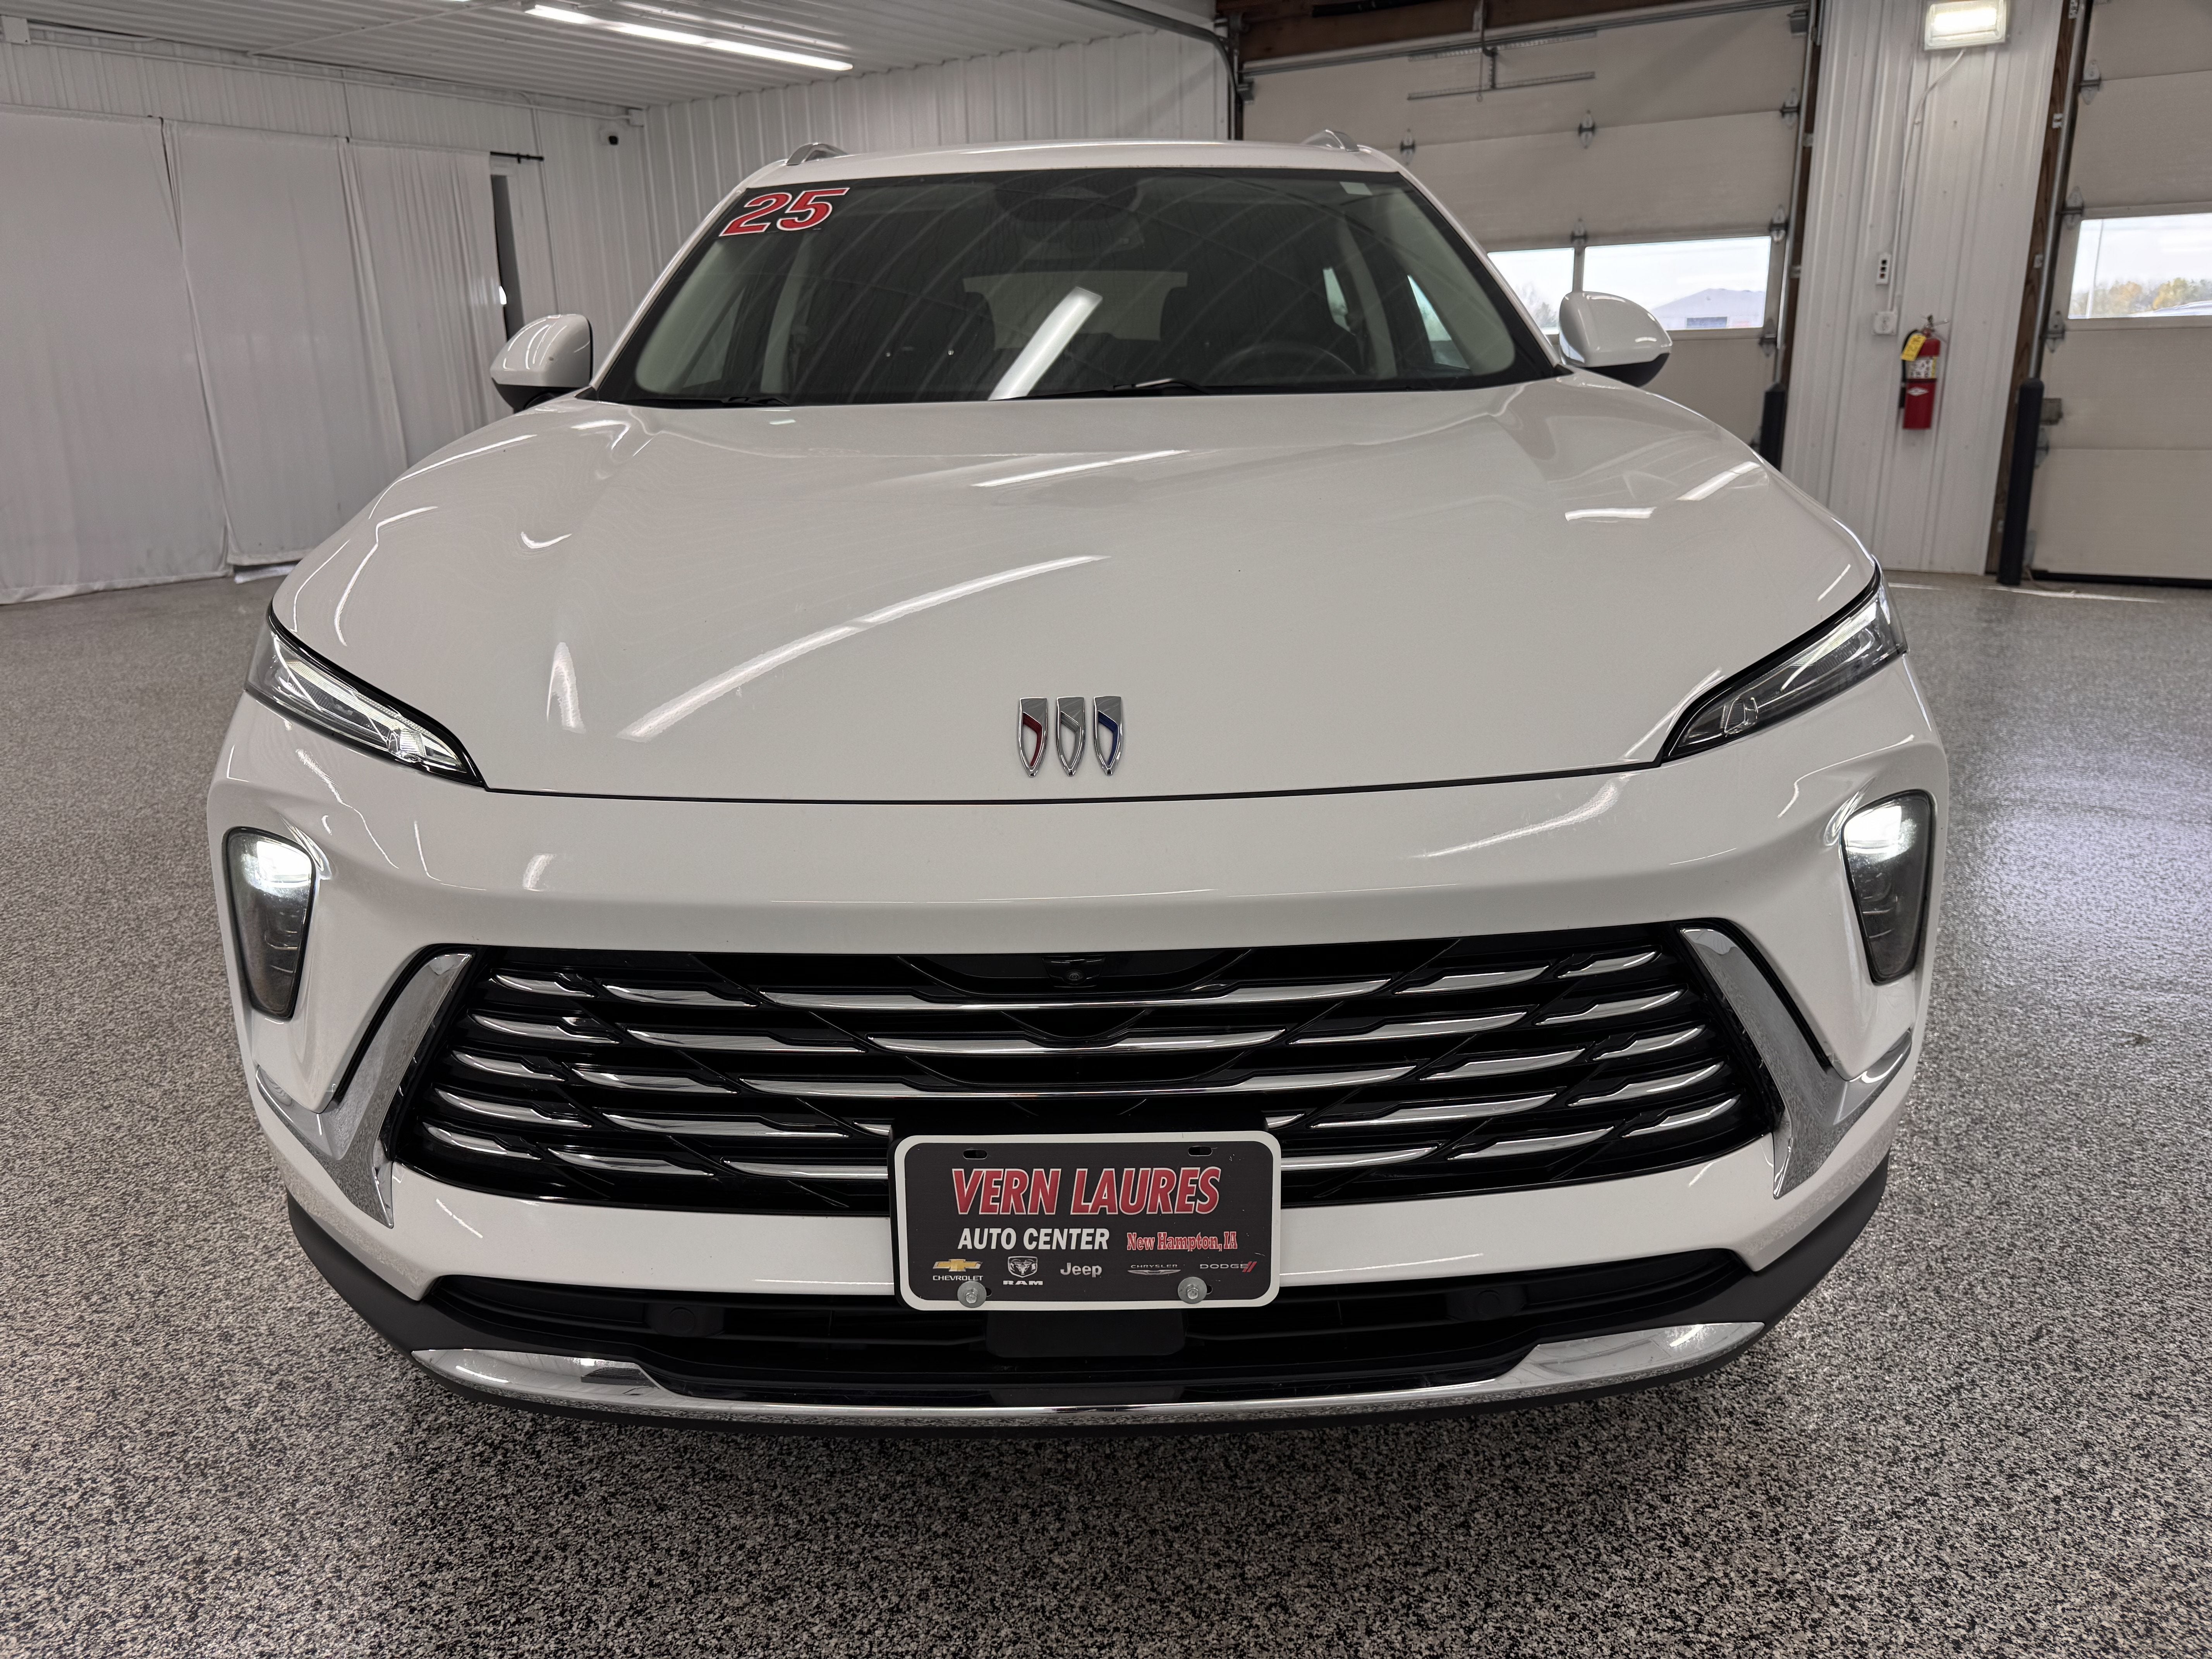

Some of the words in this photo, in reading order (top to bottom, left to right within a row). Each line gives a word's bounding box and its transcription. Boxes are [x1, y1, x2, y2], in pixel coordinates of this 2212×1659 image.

[719, 187, 850, 237] 25
[952, 1168, 1061, 1215] VERN
[1070, 1166, 1221, 1215] LAURES
[957, 1228, 1017, 1250] AUTO
[1023, 1228, 1110, 1250] CENTER
[1127, 1232, 1155, 1250] New
[1157, 1232, 1222, 1252] Hampton,
[1224, 1231, 1237, 1249] IA
[1060, 1262, 1102, 1278] Jeep
